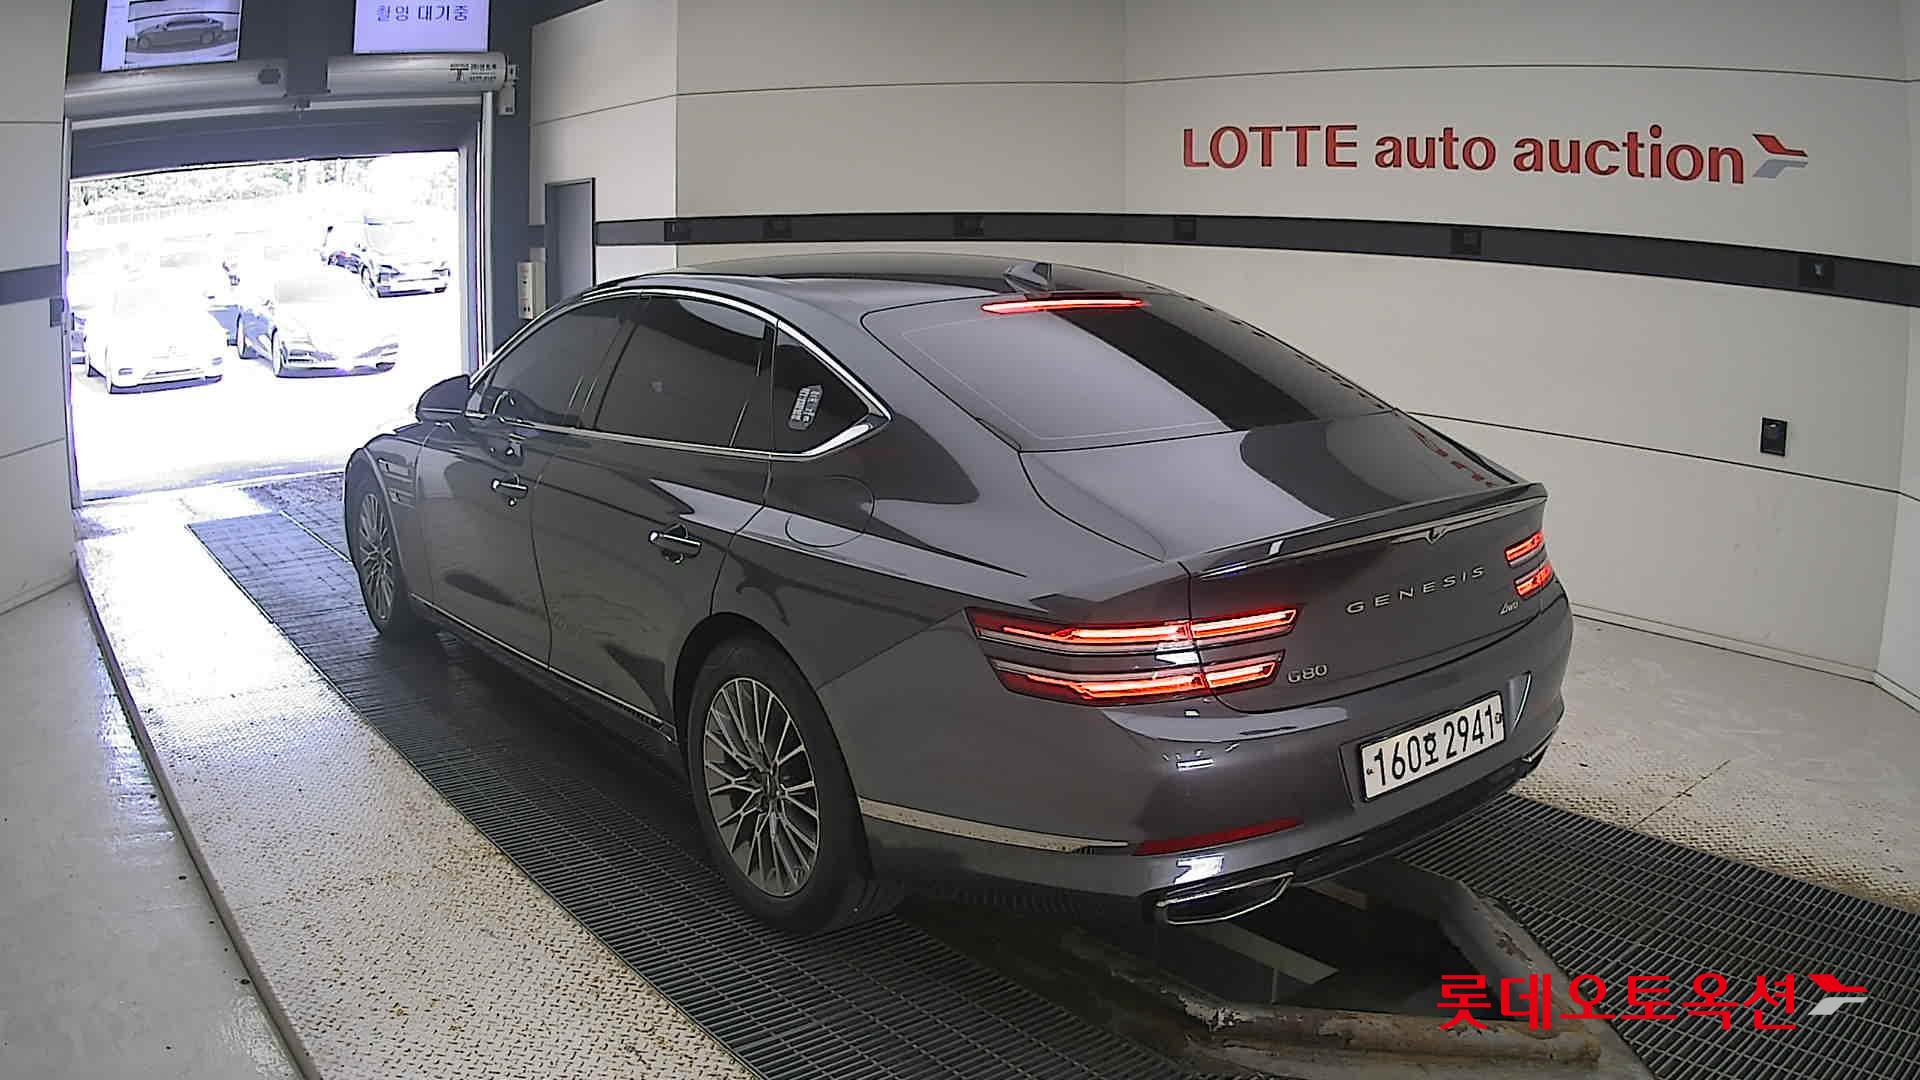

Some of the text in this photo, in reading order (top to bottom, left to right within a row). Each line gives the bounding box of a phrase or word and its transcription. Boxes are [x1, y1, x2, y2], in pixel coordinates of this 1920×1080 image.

[1183, 124, 1745, 184] LOTTE auto auction
[1346, 565, 1485, 614] GENESIS
[1287, 664, 1328, 683] G80
[1443, 704, 1494, 759] 2941
